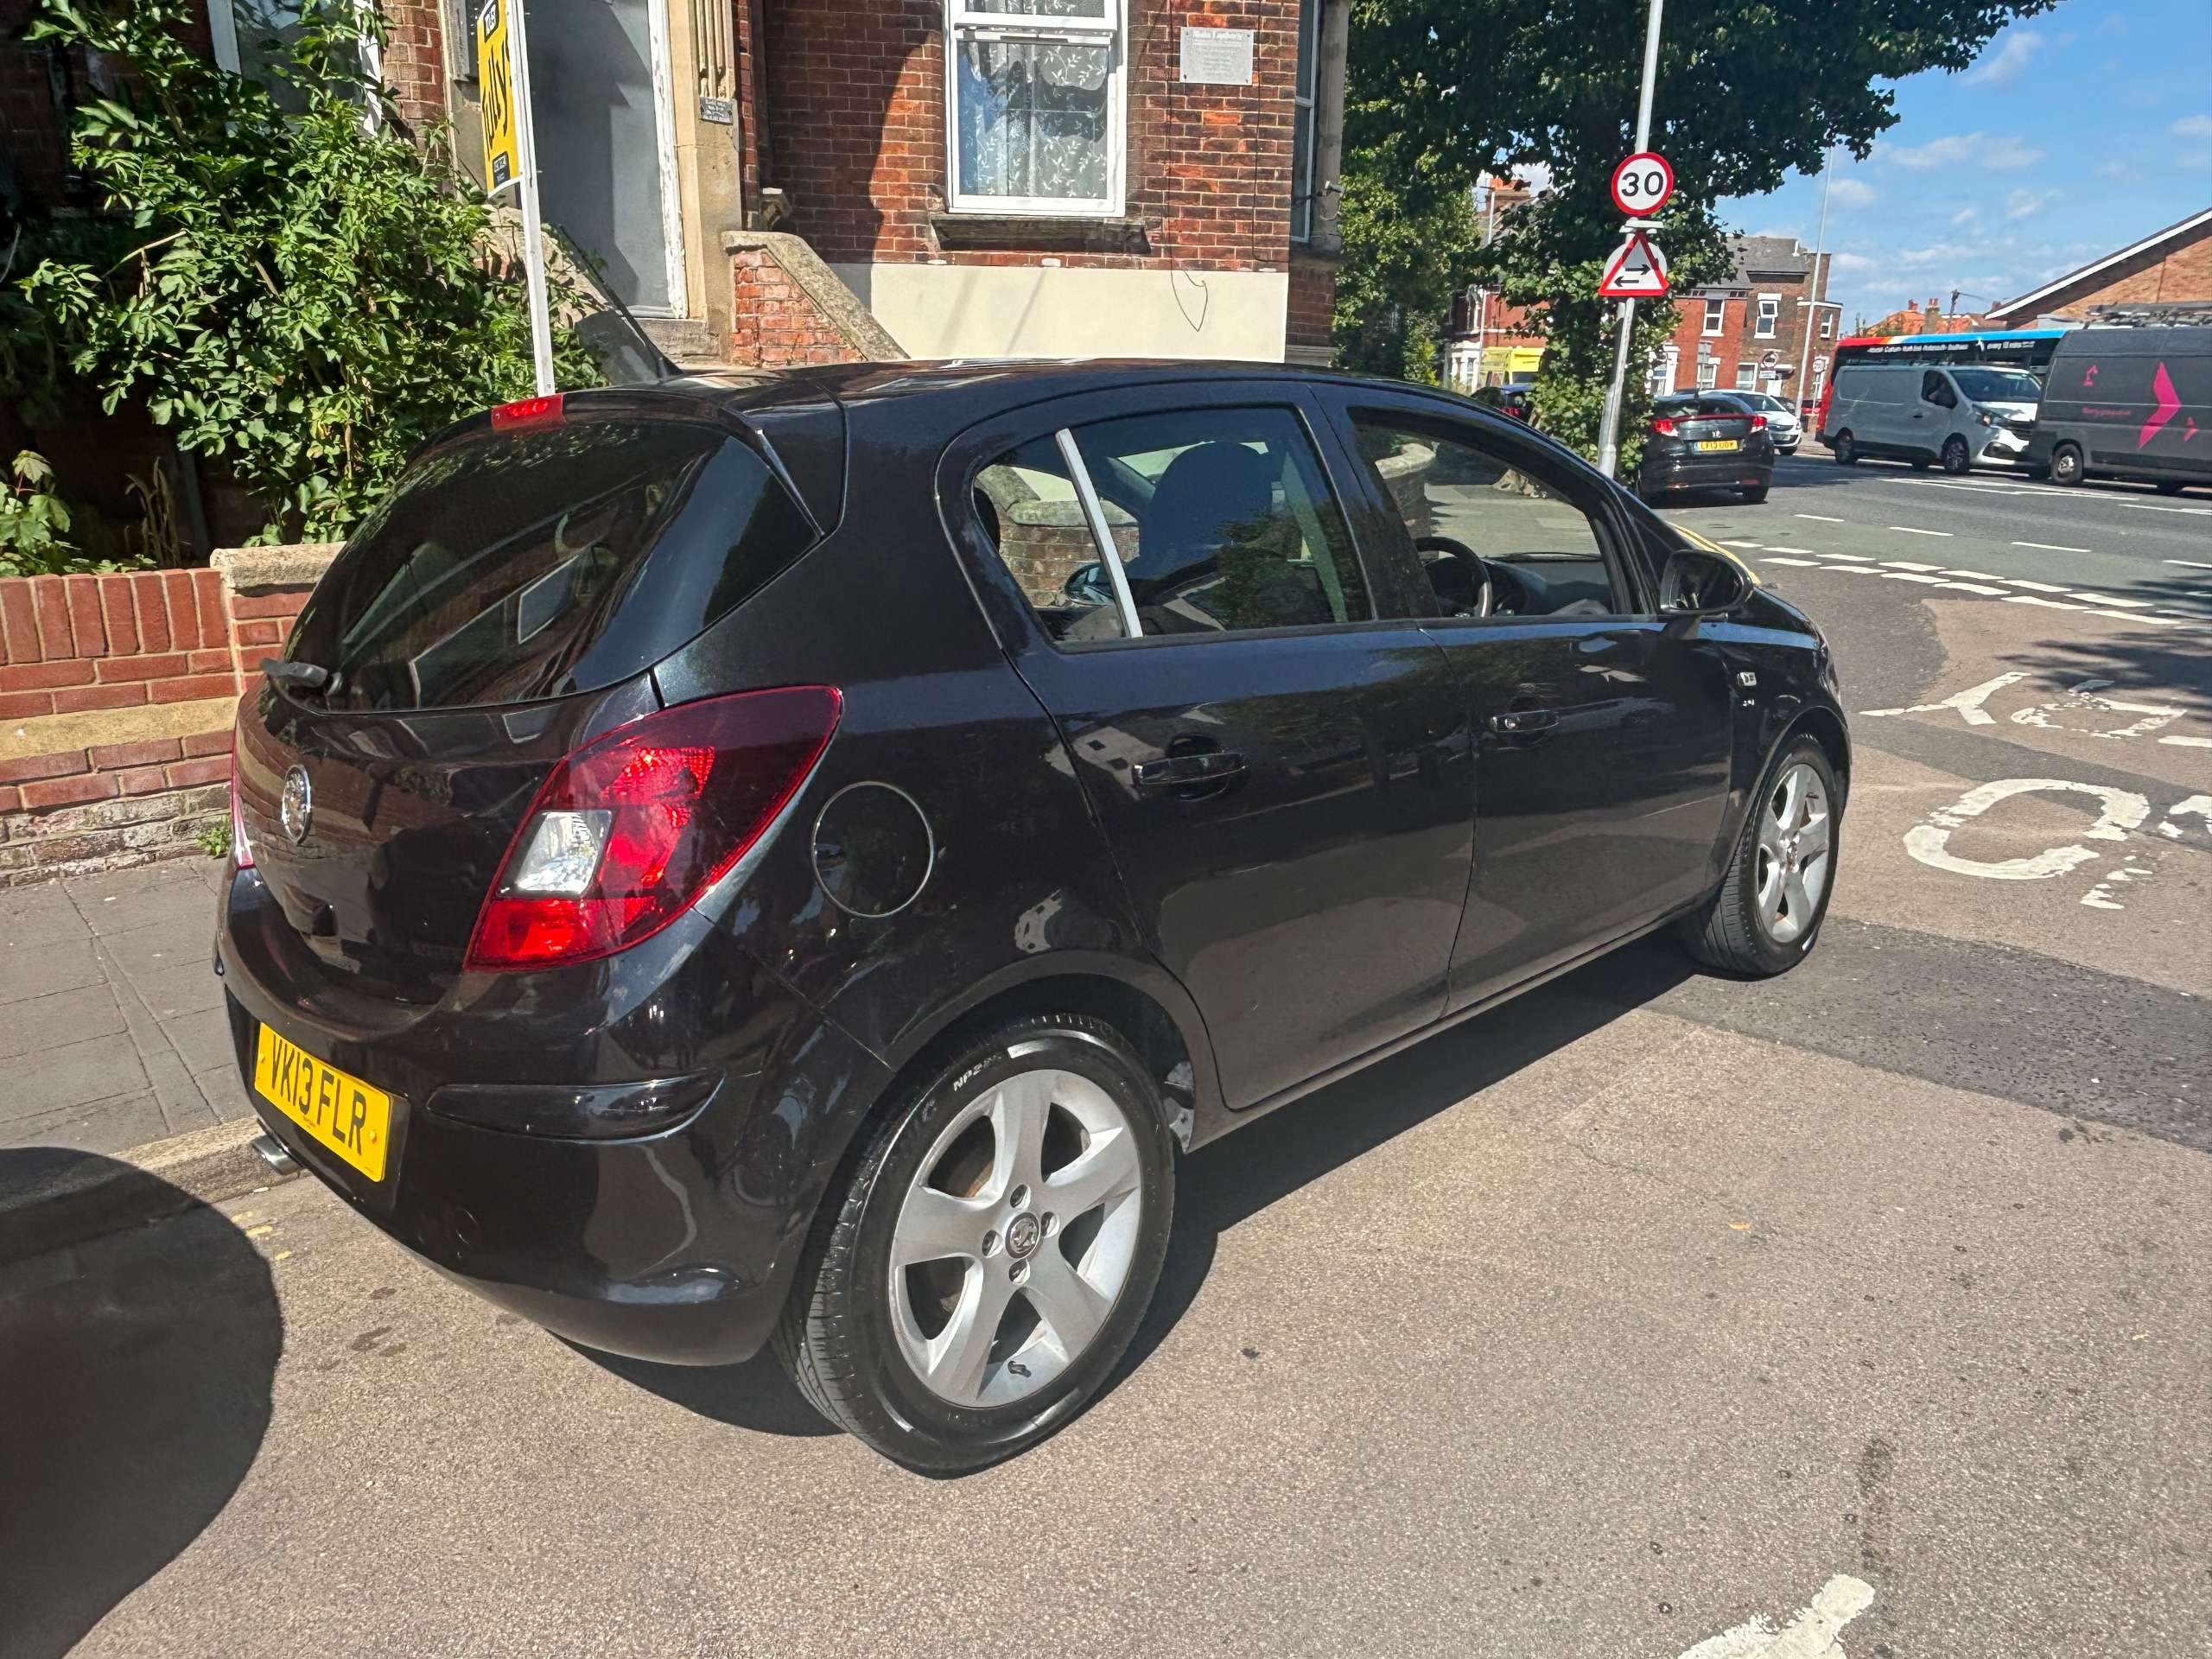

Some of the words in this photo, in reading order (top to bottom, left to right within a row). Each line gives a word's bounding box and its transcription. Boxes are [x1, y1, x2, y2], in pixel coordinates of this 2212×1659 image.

[1621, 171, 1664, 197] 30
[271, 1033, 314, 1115] VK13
[316, 1068, 366, 1155] FLR
